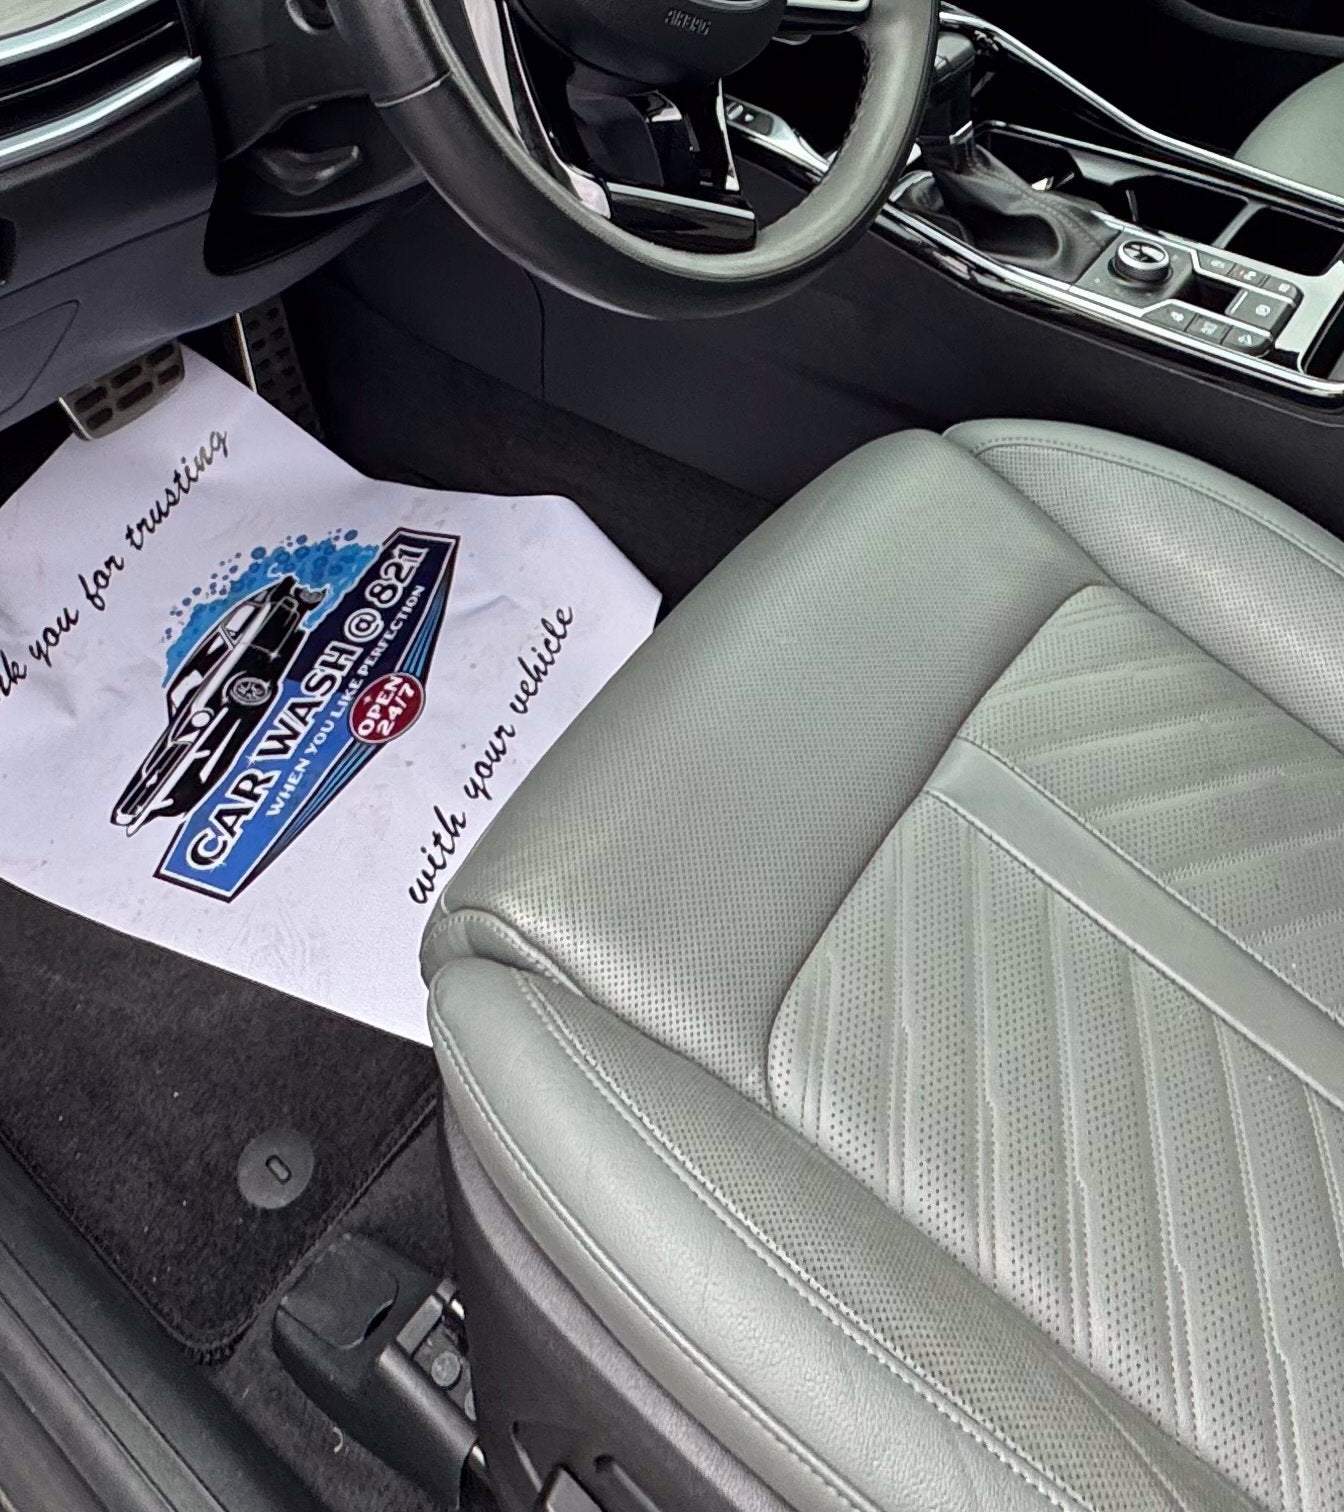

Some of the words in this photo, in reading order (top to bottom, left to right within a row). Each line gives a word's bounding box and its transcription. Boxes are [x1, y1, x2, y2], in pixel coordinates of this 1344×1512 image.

[29, 607, 80, 668] you
[78, 554, 125, 611] for
[125, 430, 229, 551] trusting
[186, 769, 274, 871] CAR
[256, 640, 364, 761] WASH
[343, 607, 385, 643] @
[365, 541, 430, 608] 821
[265, 758, 311, 818] WHEN
[308, 719, 336, 757] YOU
[334, 677, 363, 722] LIKE
[356, 584, 426, 678] PERFECTION
[357, 674, 406, 737] OPEN
[377, 681, 420, 737] 24/7
[408, 804, 467, 905] with
[463, 724, 517, 801] your
[509, 606, 574, 715] vehicle
